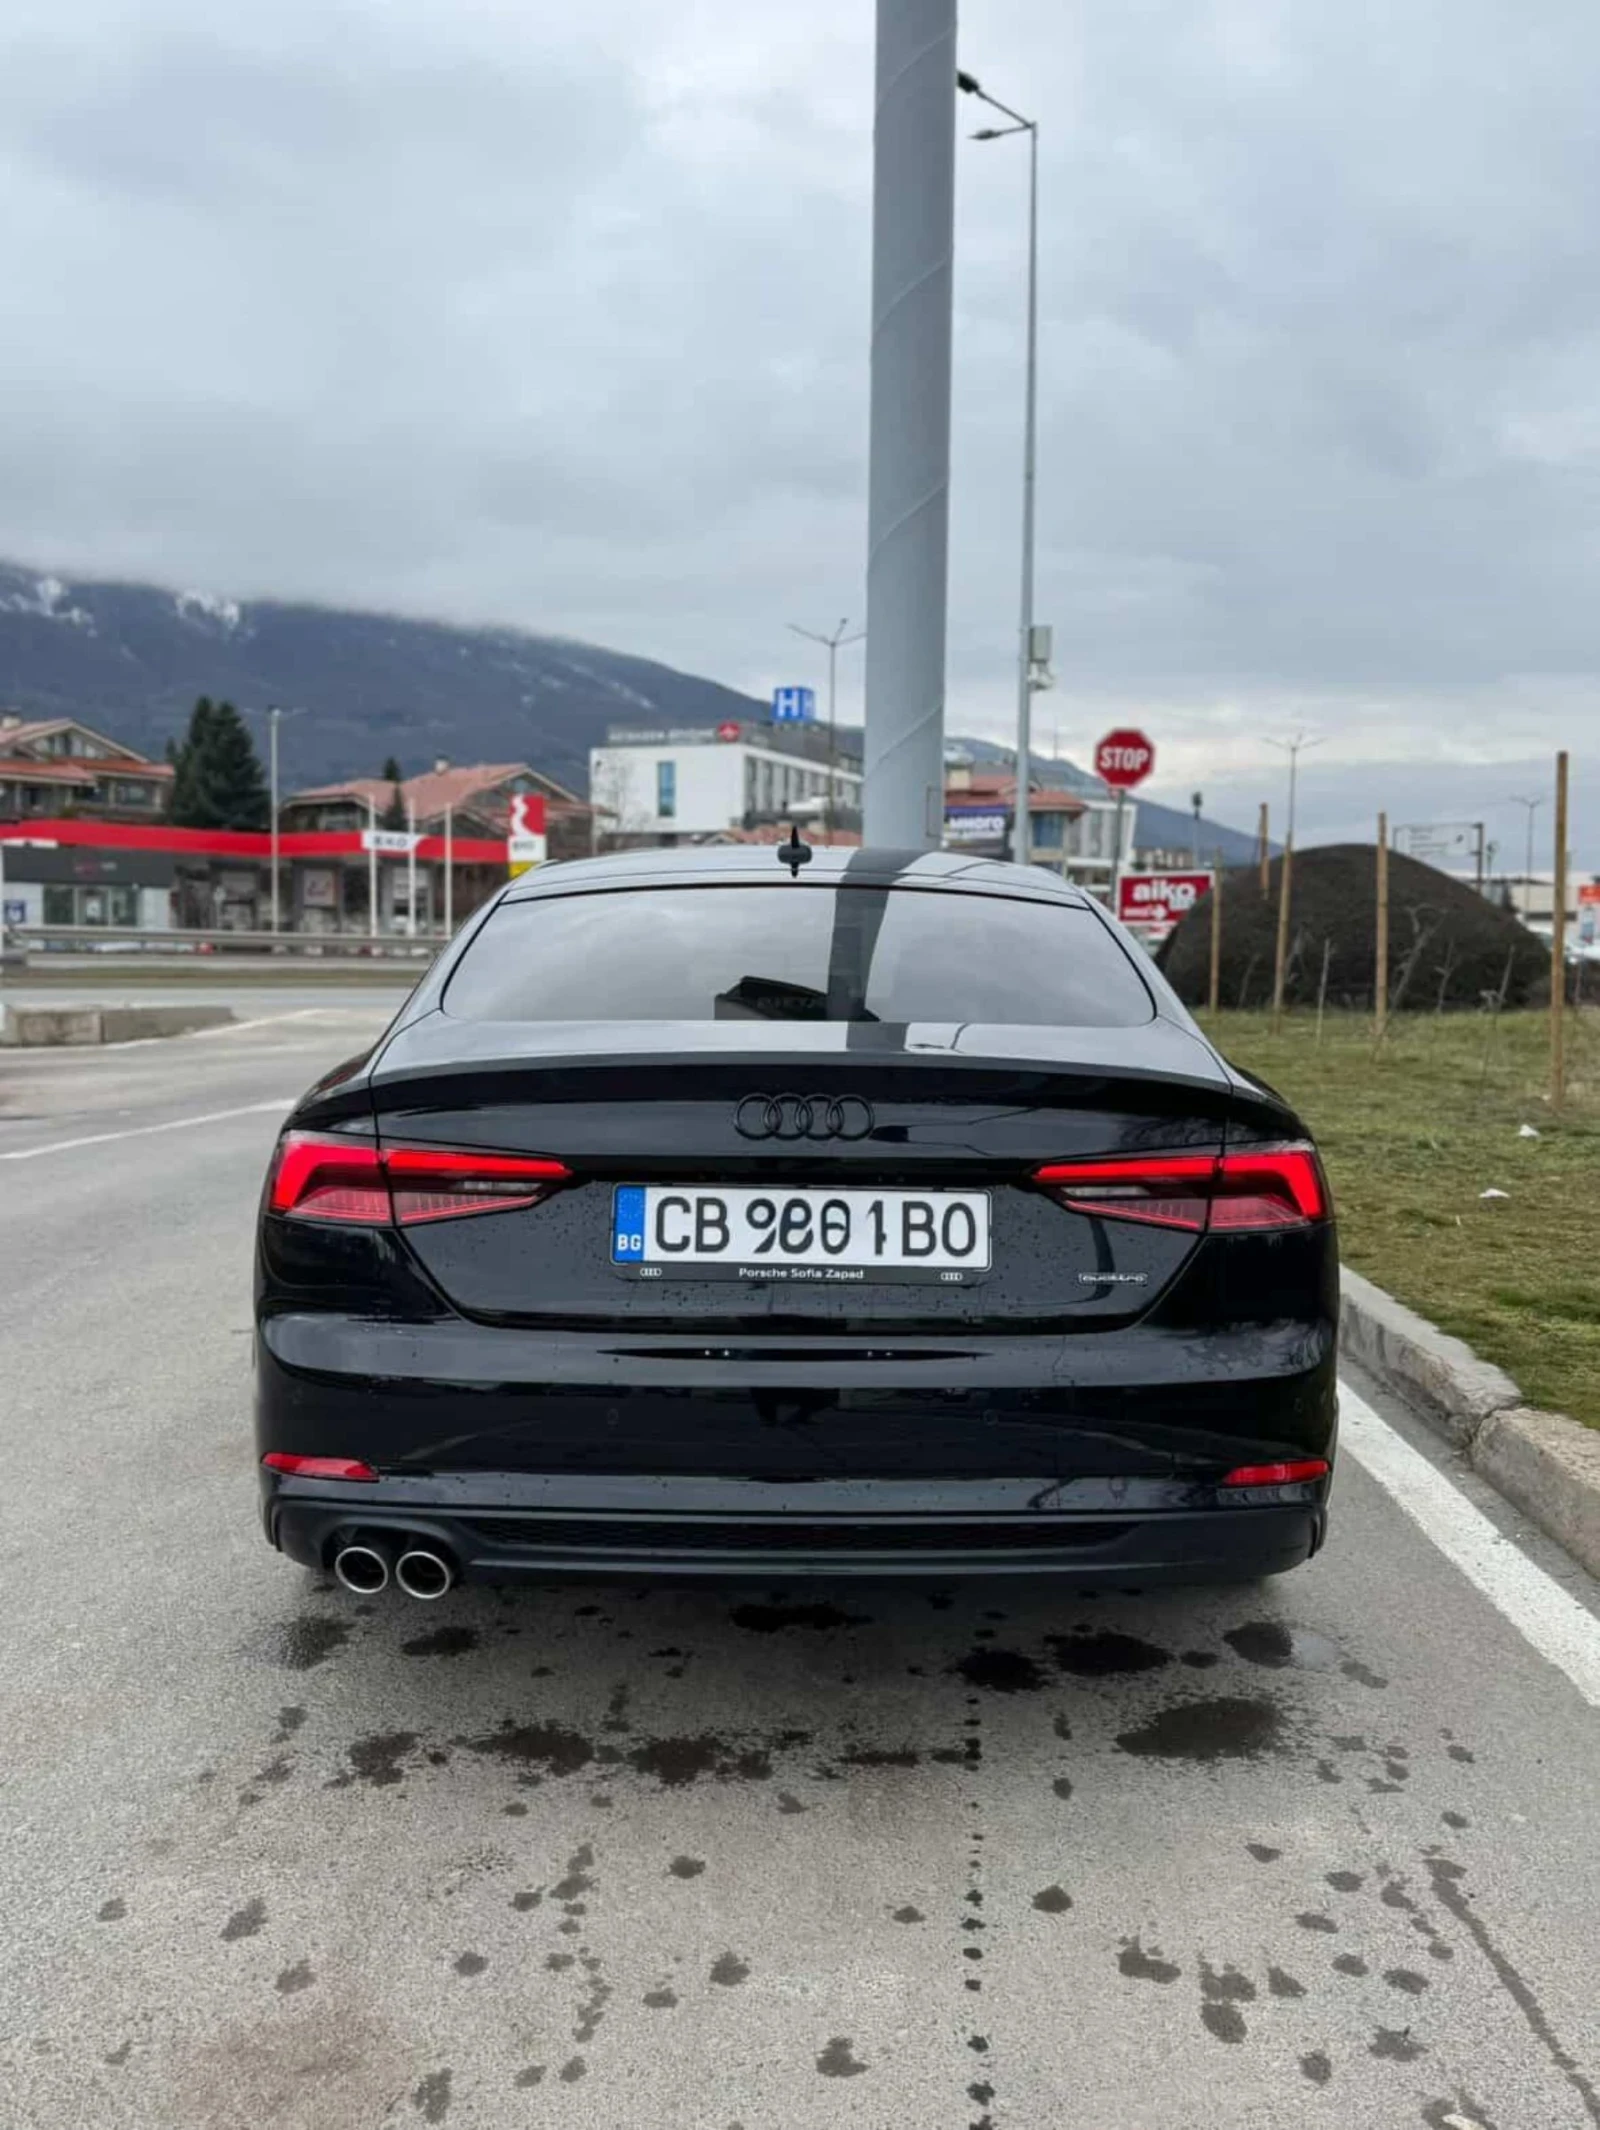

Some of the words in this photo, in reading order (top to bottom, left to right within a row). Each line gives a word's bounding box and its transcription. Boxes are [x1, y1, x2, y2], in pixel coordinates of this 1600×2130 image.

[1100, 747, 1149, 770] STOP
[1132, 879, 1196, 903] aiko
[656, 1196, 731, 1254] CB
[901, 1200, 977, 1258] BO
[617, 1235, 642, 1252] BG
[739, 1267, 788, 1279] Porsche
[791, 1267, 823, 1280] Sofia
[825, 1268, 864, 1282] Zapad
